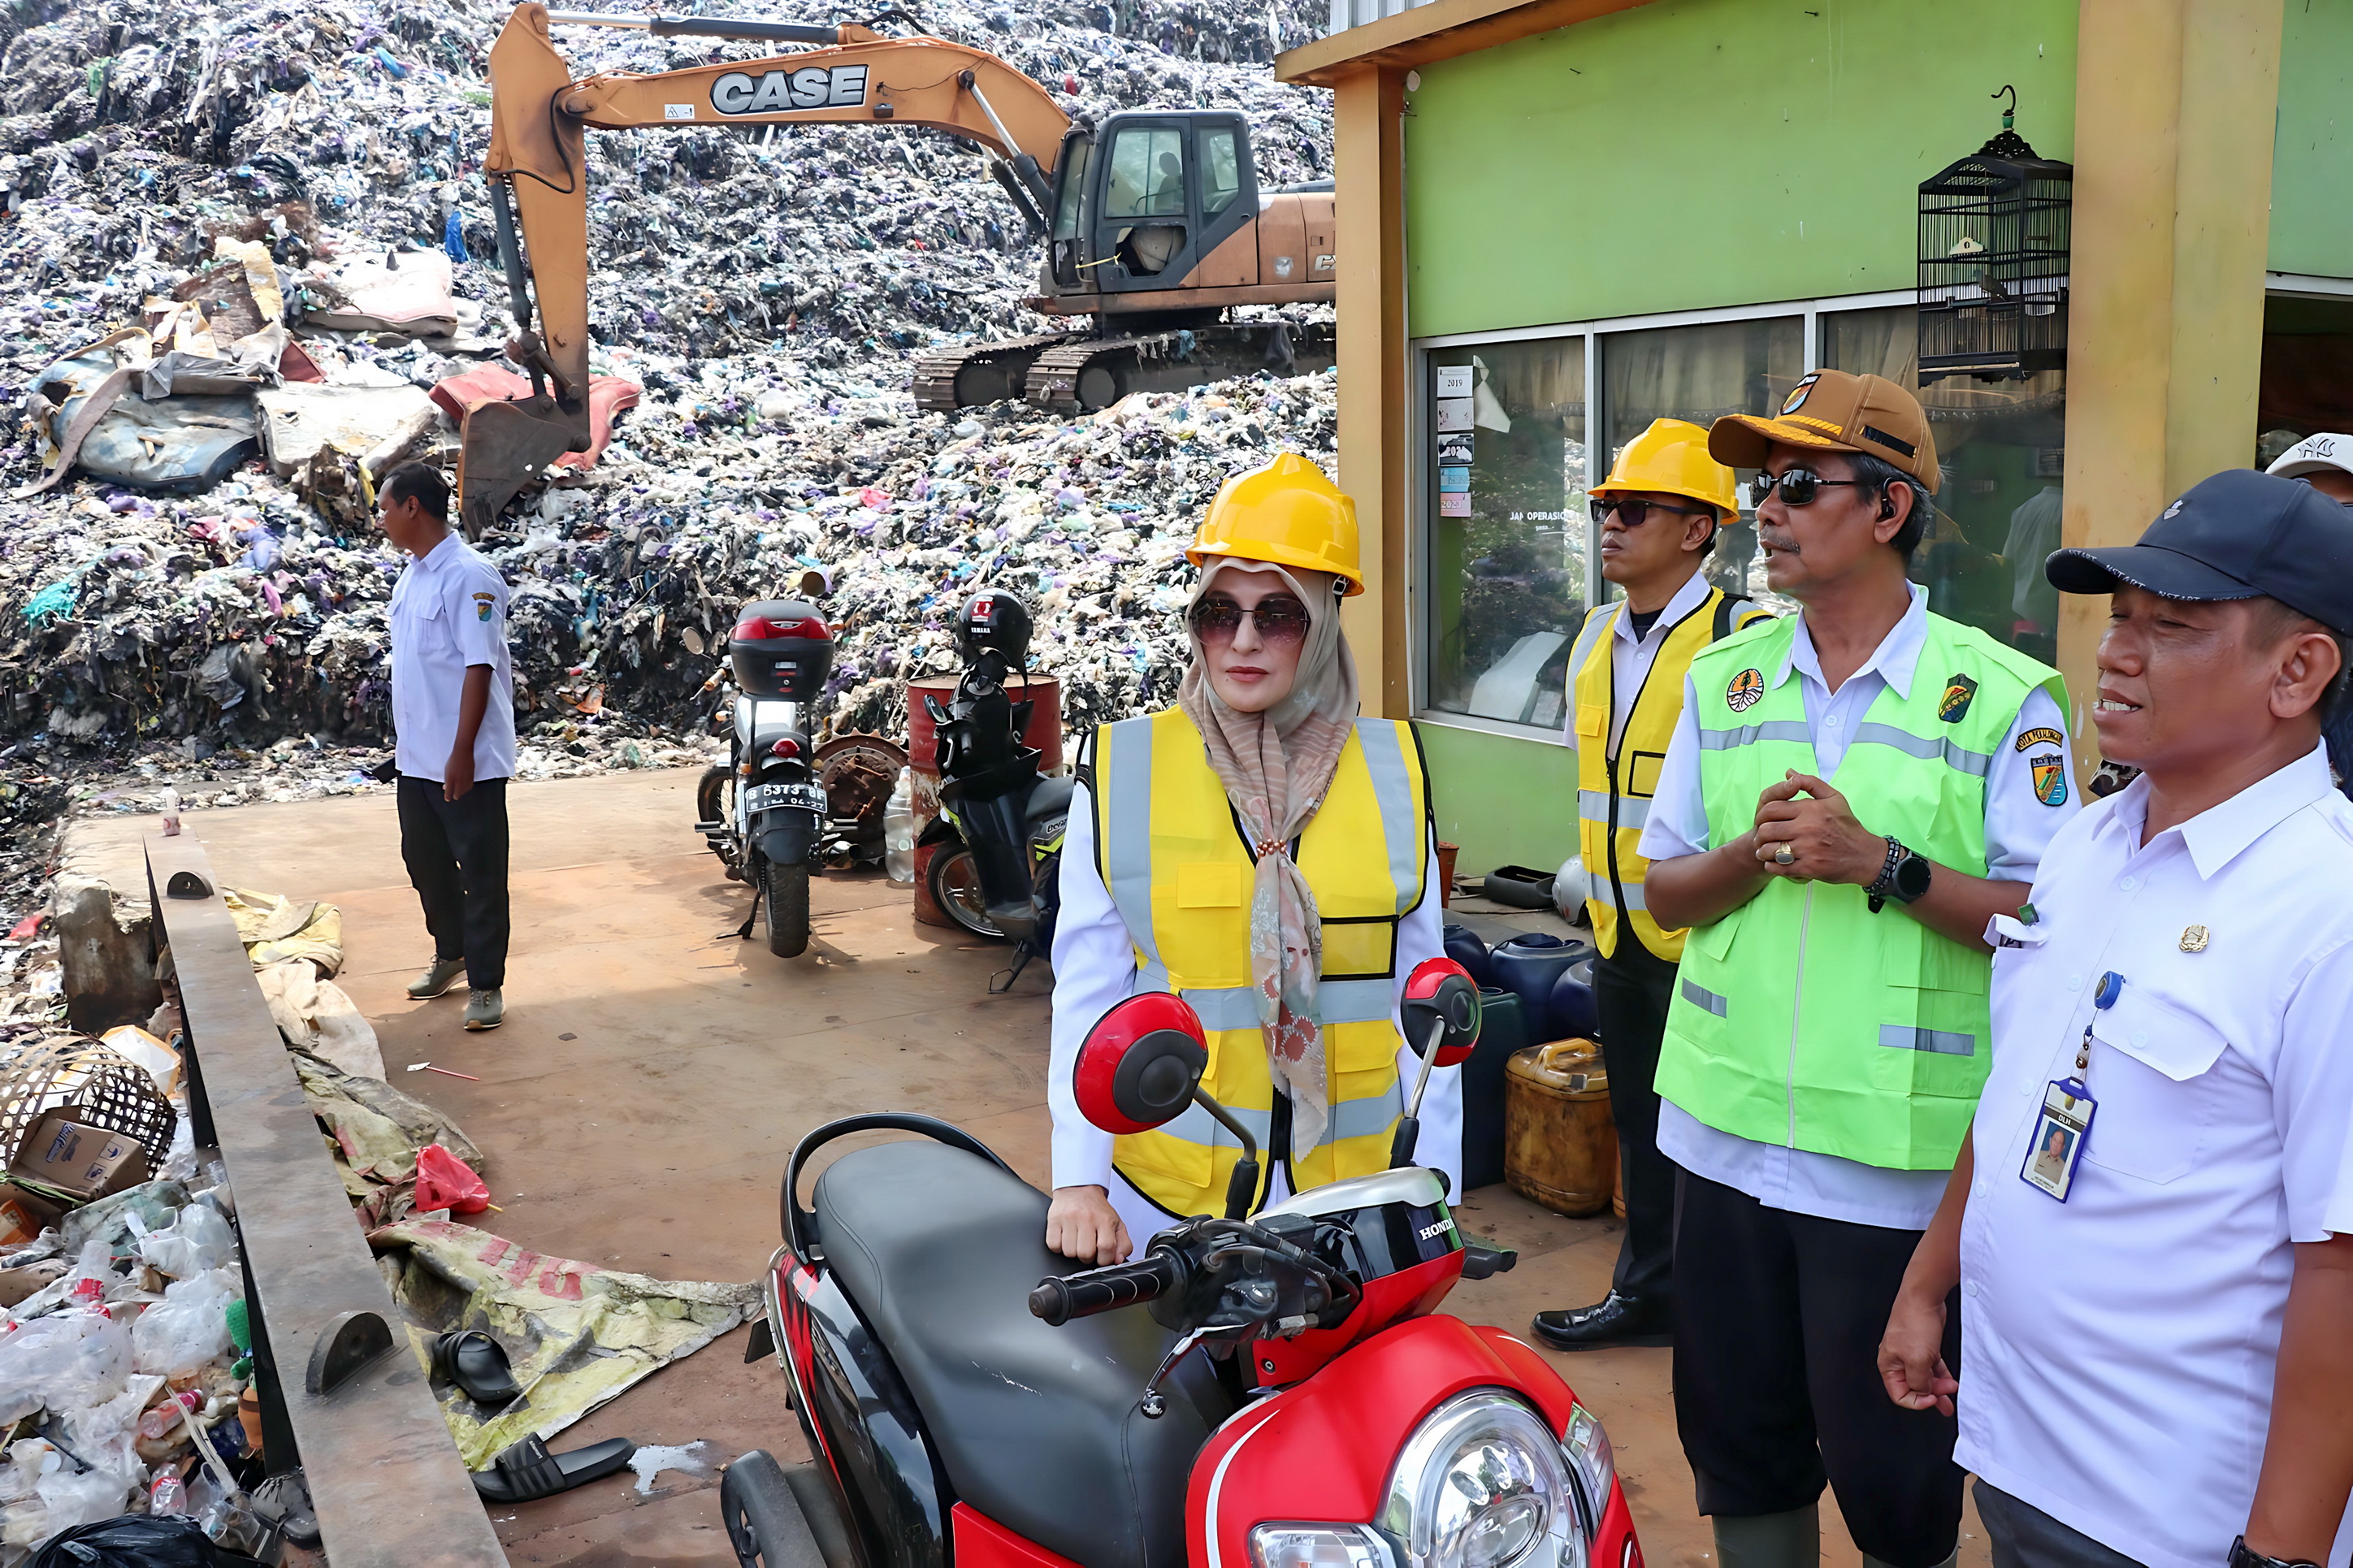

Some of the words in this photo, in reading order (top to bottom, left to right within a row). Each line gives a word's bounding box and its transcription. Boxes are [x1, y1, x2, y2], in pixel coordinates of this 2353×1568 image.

[712, 67, 867, 113] CASE
[1447, 379, 1462, 387] 2019
[748, 790, 757, 799] B
[764, 784, 800, 796] 6373
